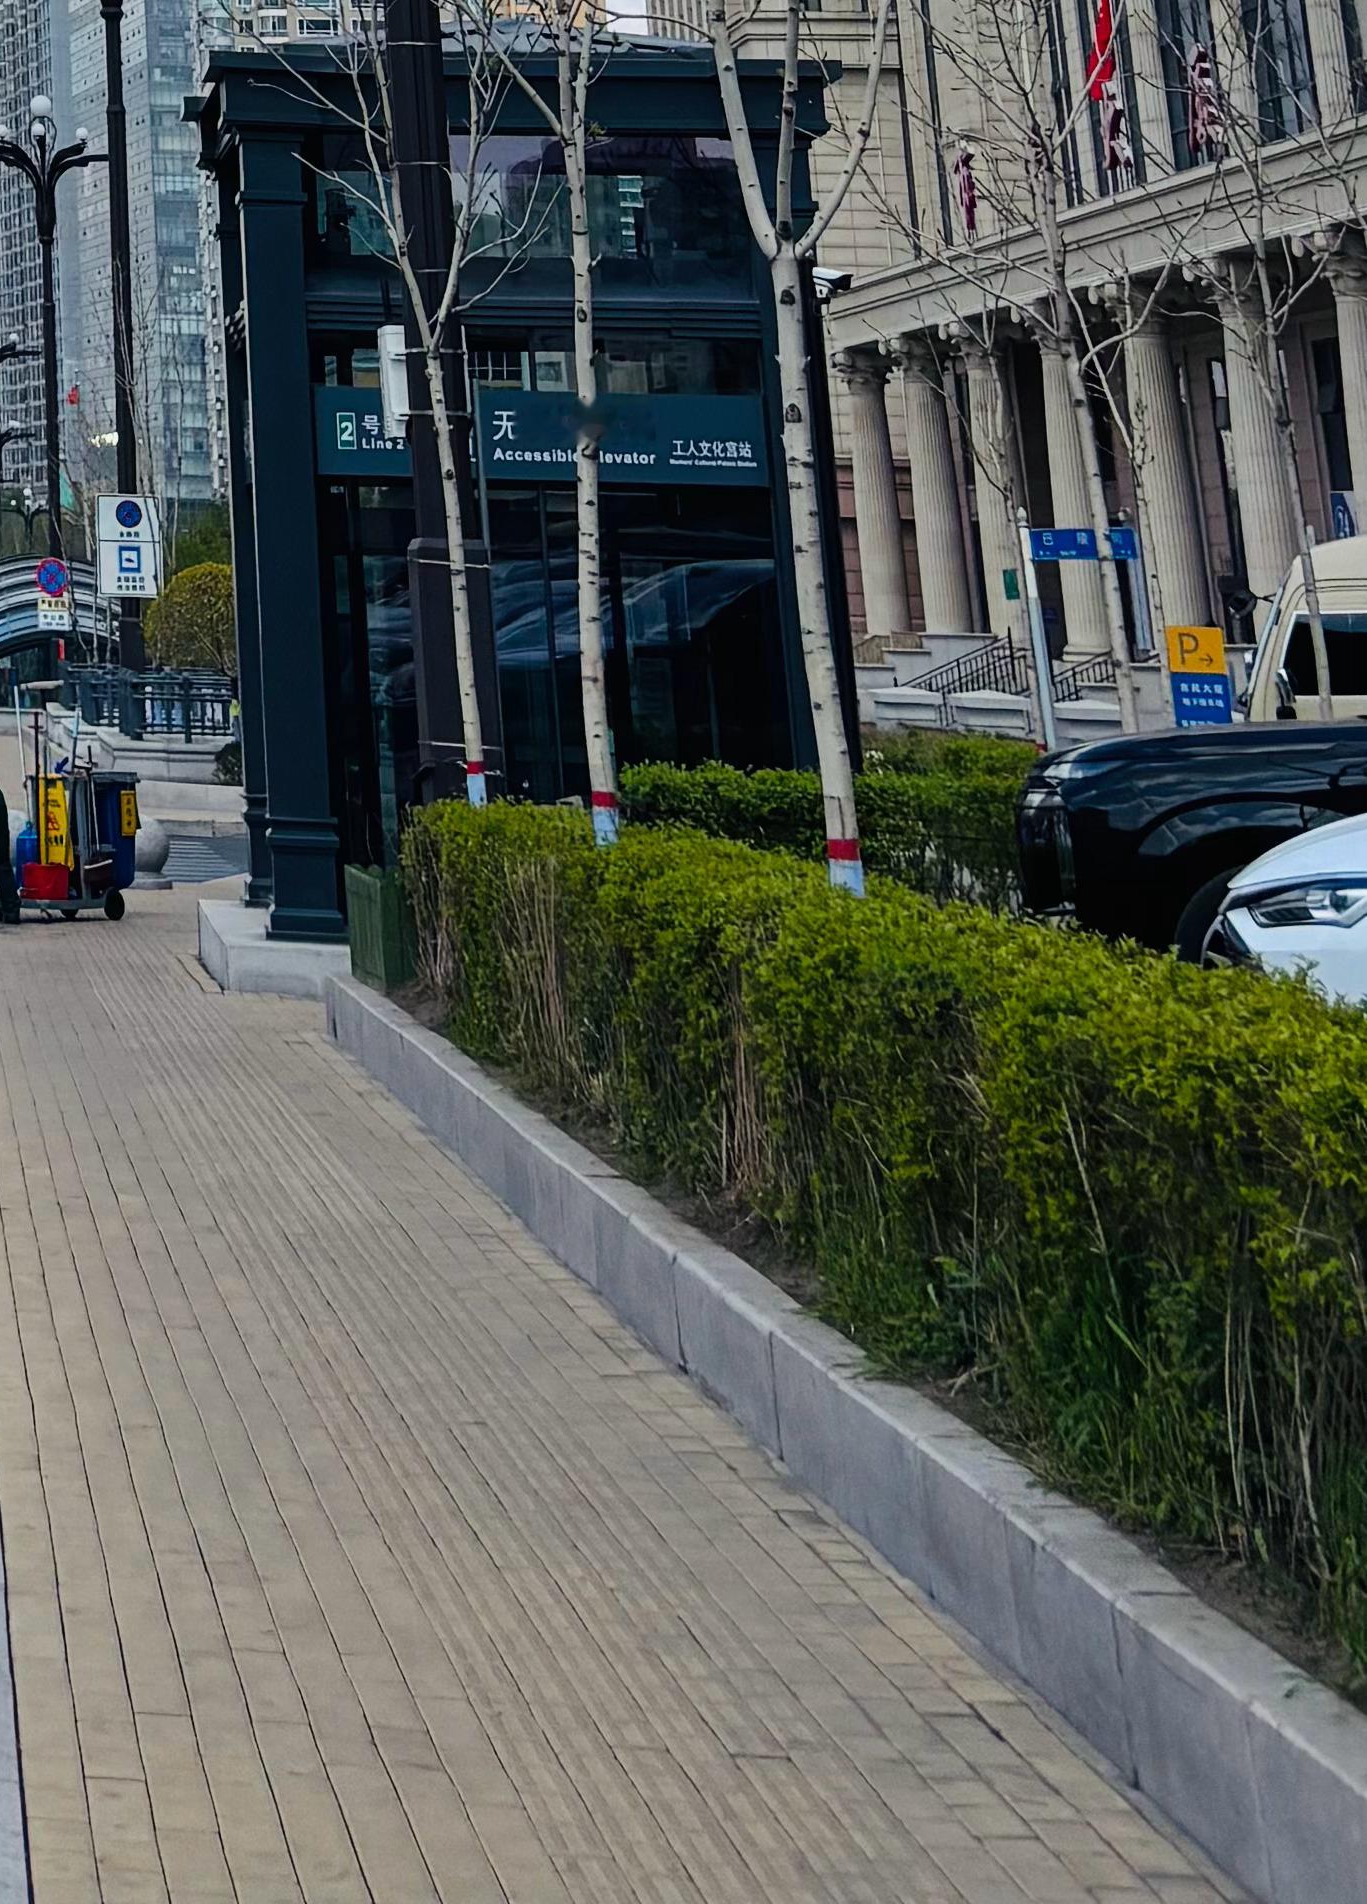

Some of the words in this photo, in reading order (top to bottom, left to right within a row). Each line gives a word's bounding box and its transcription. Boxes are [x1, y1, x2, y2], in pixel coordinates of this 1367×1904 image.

[361, 437, 393, 449] Line
[395, 439, 405, 450] 2
[671, 439, 753, 458] 工人文化宫站
[599, 450, 657, 465] levator
[1178, 632, 1199, 666] P
